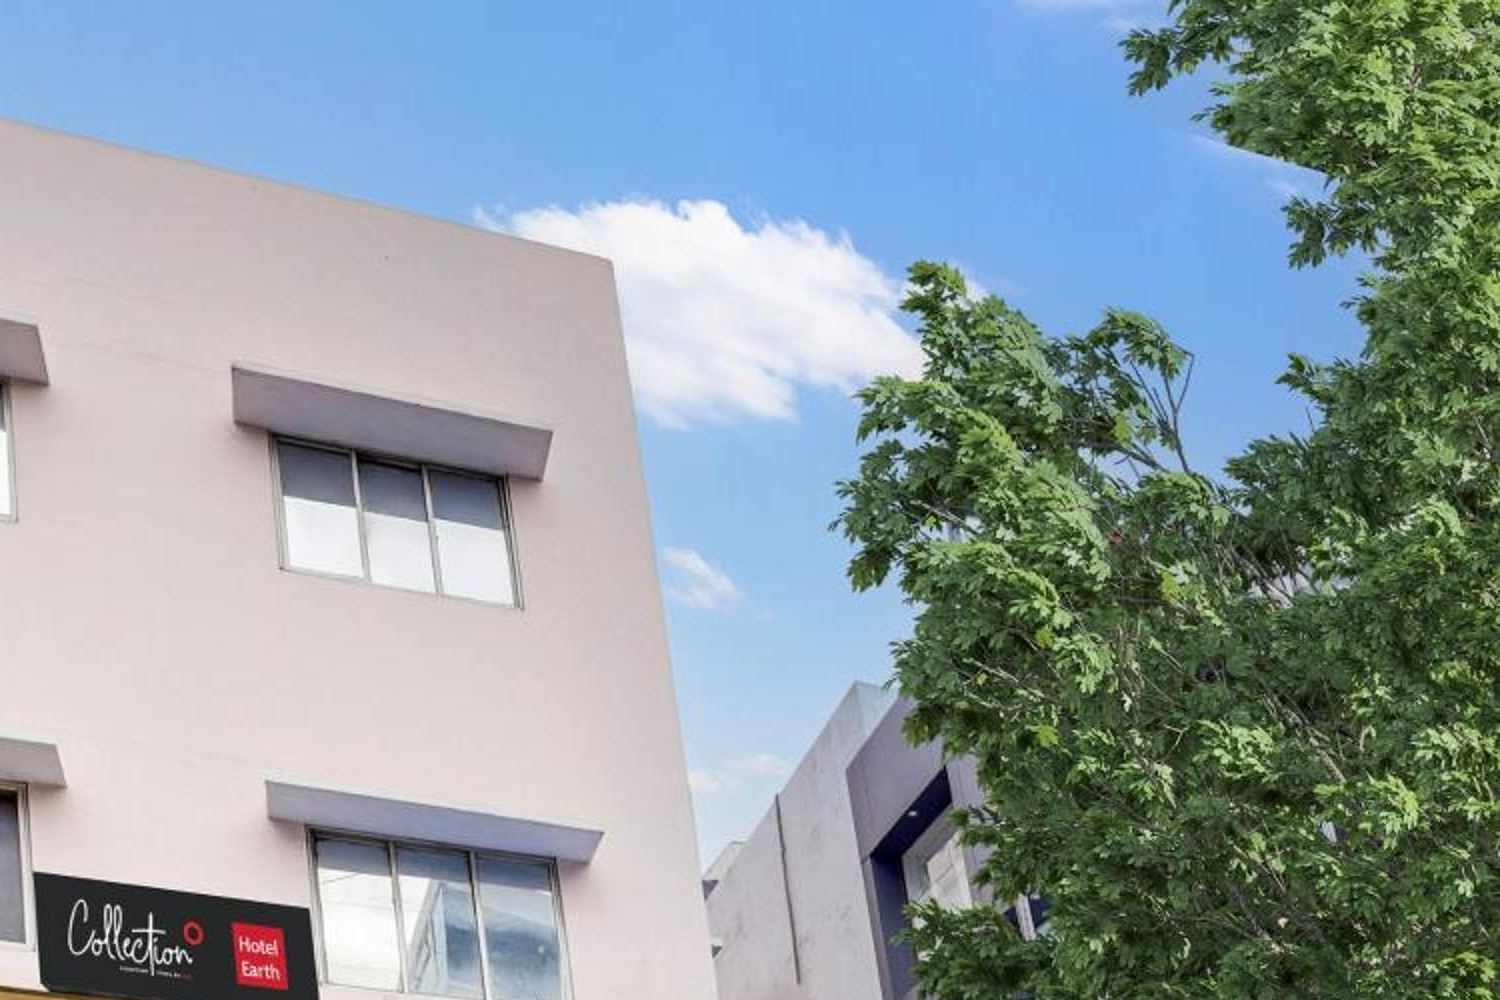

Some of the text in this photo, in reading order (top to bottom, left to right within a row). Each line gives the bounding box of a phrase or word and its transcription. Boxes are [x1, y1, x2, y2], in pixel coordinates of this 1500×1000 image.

[66, 898, 193, 977] Collection
[238, 936, 278, 958] Hotel
[241, 960, 281, 981] Earth
